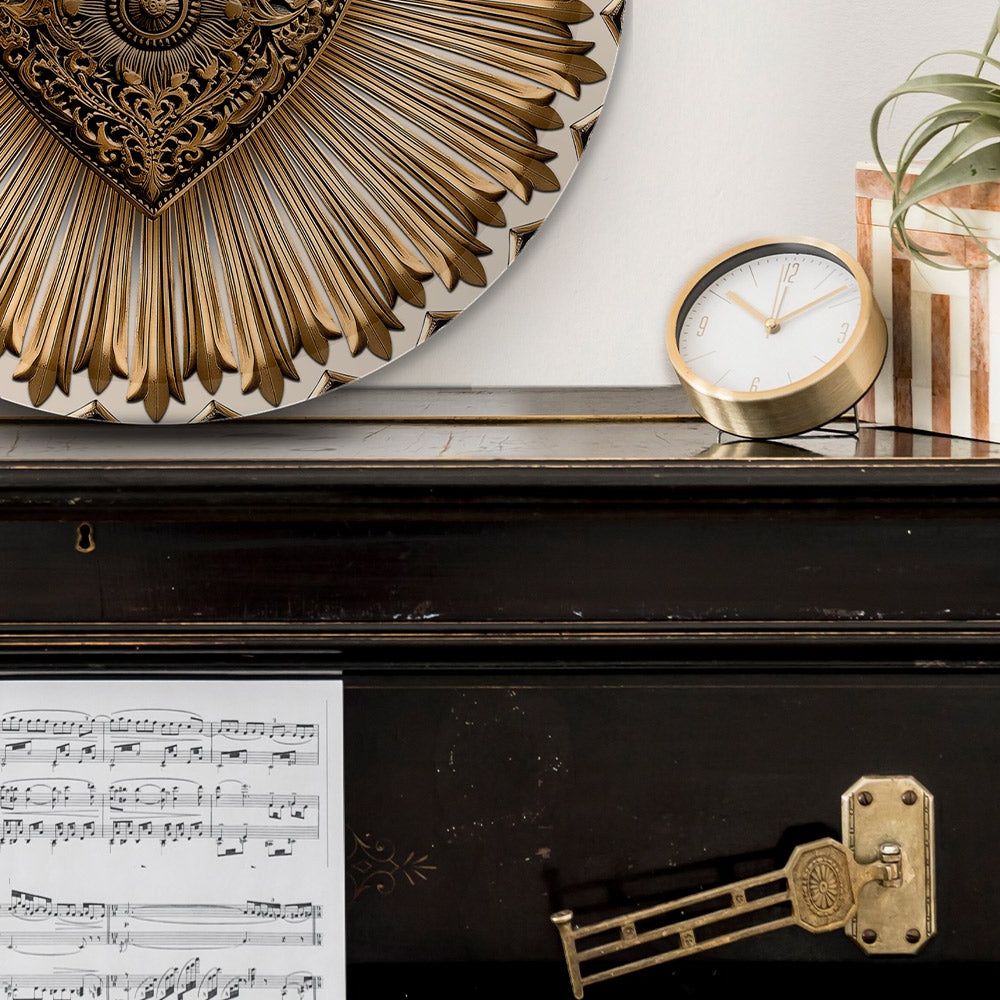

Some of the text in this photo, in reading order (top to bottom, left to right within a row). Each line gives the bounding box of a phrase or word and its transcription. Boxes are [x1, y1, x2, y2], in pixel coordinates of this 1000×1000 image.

[783, 262, 800, 284] 12
[696, 315, 709, 337] 9
[837, 322, 850, 345] 3
